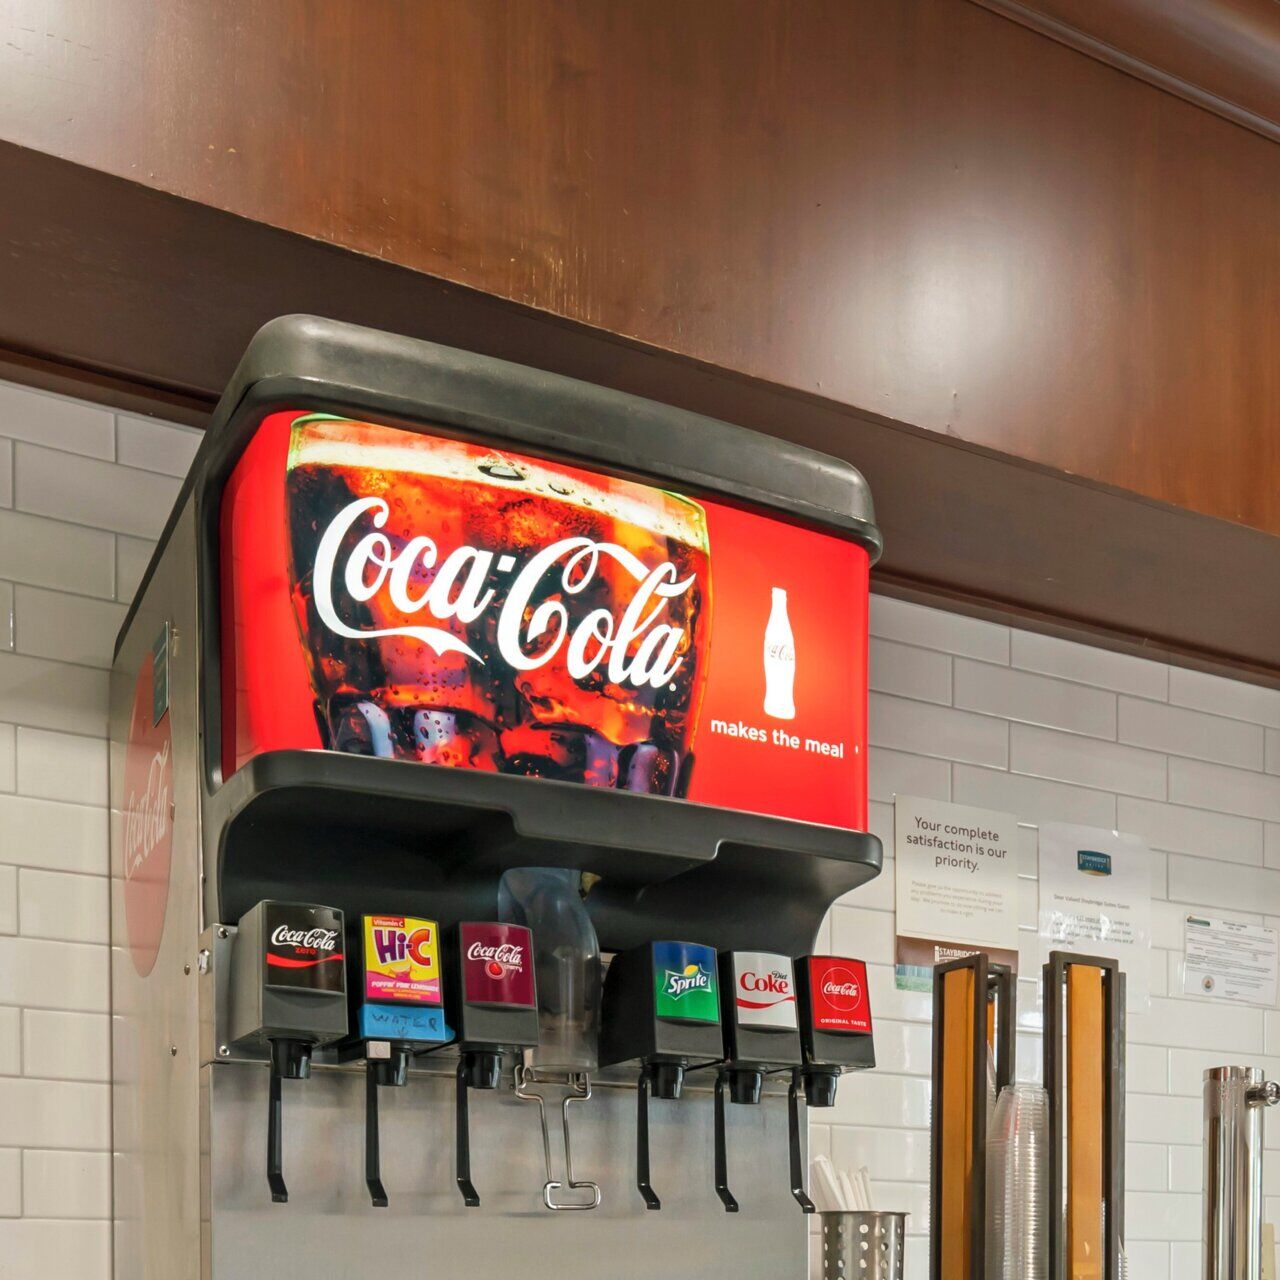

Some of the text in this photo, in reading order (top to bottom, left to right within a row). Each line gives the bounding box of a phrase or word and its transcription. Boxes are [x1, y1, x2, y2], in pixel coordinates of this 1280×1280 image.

[313, 497, 696, 690] Coca-Cola
[711, 719, 843, 758] makes the meal
[914, 816, 999, 842] Your complete
[906, 834, 1007, 859] satisfaction is our
[935, 855, 980, 873] priority.
[271, 924, 339, 951] Coca-Cola
[373, 927, 433, 968] Hi-C
[467, 941, 524, 964] Coca-Cola
[667, 972, 708, 994] Sprite
[740, 971, 790, 994] Coke
[772, 970, 788, 980] Diet
[372, 1013, 439, 1032] WATER
